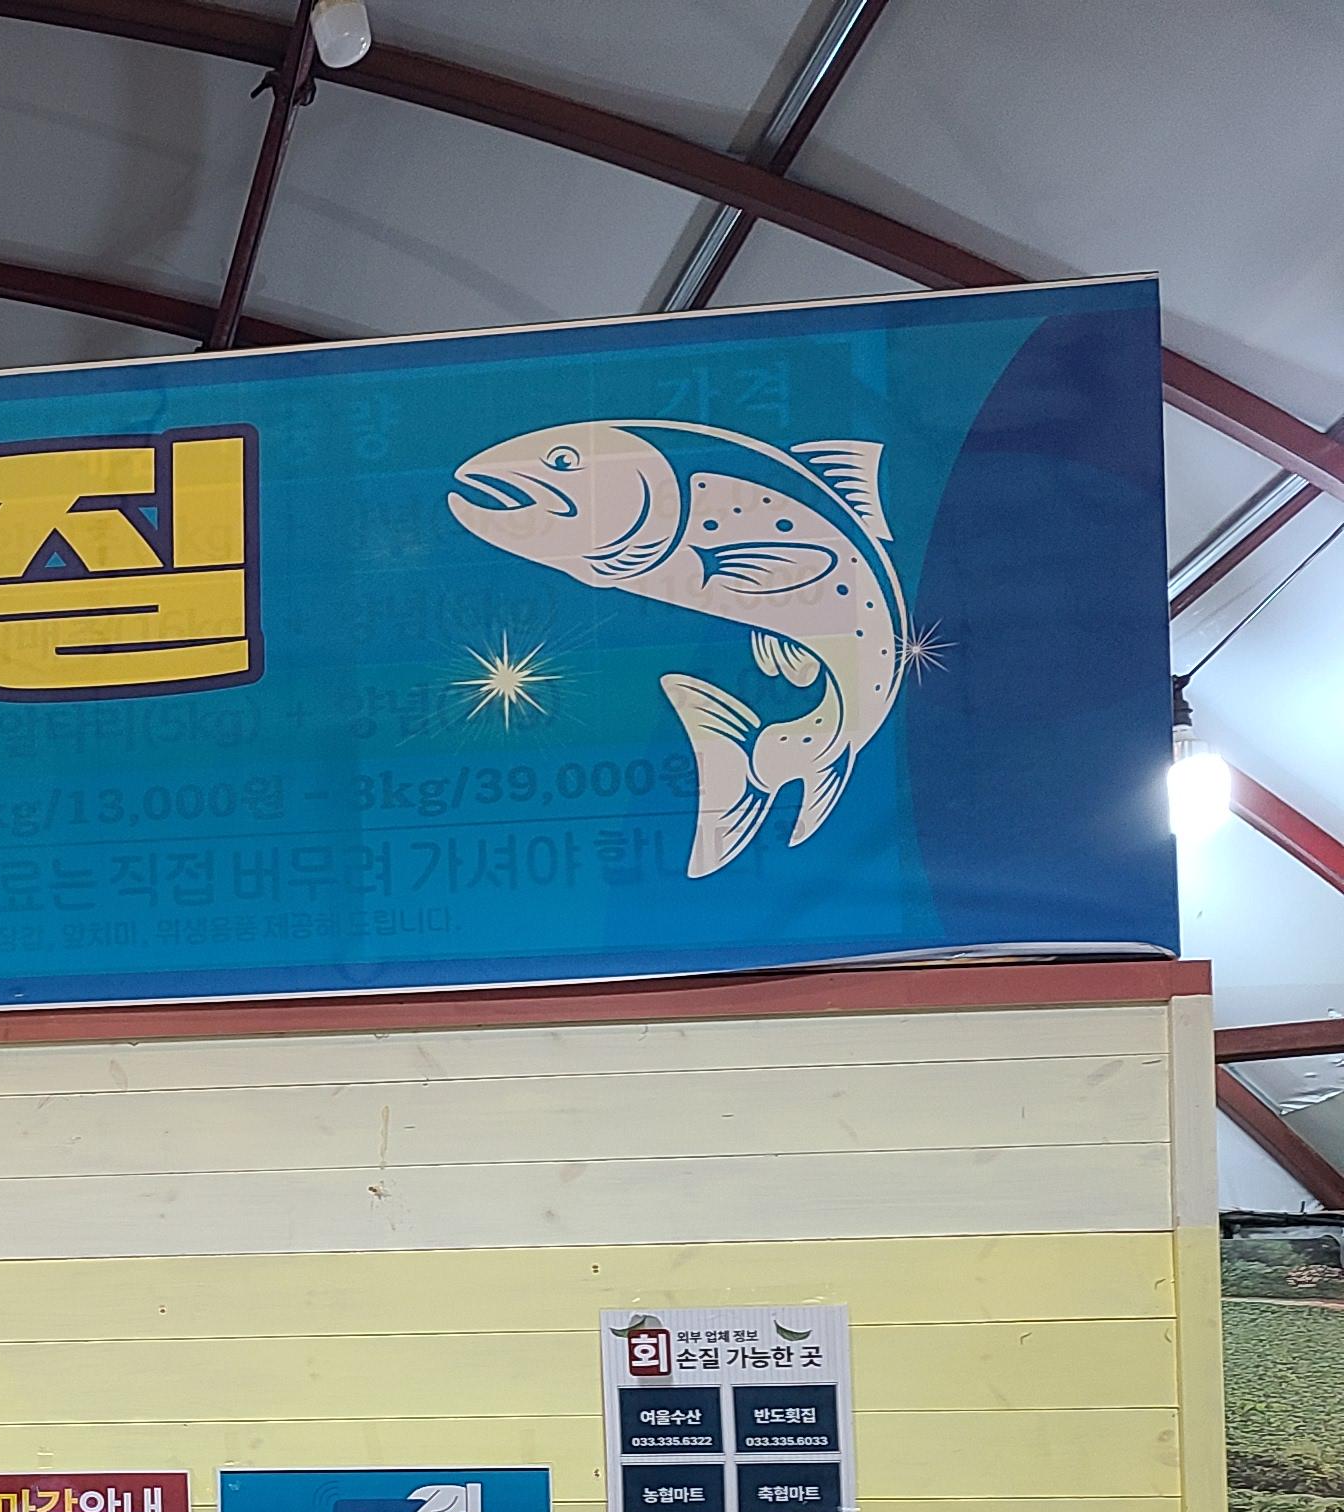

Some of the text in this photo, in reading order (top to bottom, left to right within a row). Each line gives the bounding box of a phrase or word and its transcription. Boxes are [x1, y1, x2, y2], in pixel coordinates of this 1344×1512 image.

[676, 1329, 759, 1344] 외부 업체 정보
[630, 1332, 668, 1373] 회
[676, 1345, 823, 1370] 손질 가능한 곳
[639, 1408, 702, 1426] 여울수산
[753, 1407, 817, 1425] 반도횟집
[642, 1486, 706, 1504] 농협마트
[757, 1485, 821, 1502] 축협마트
